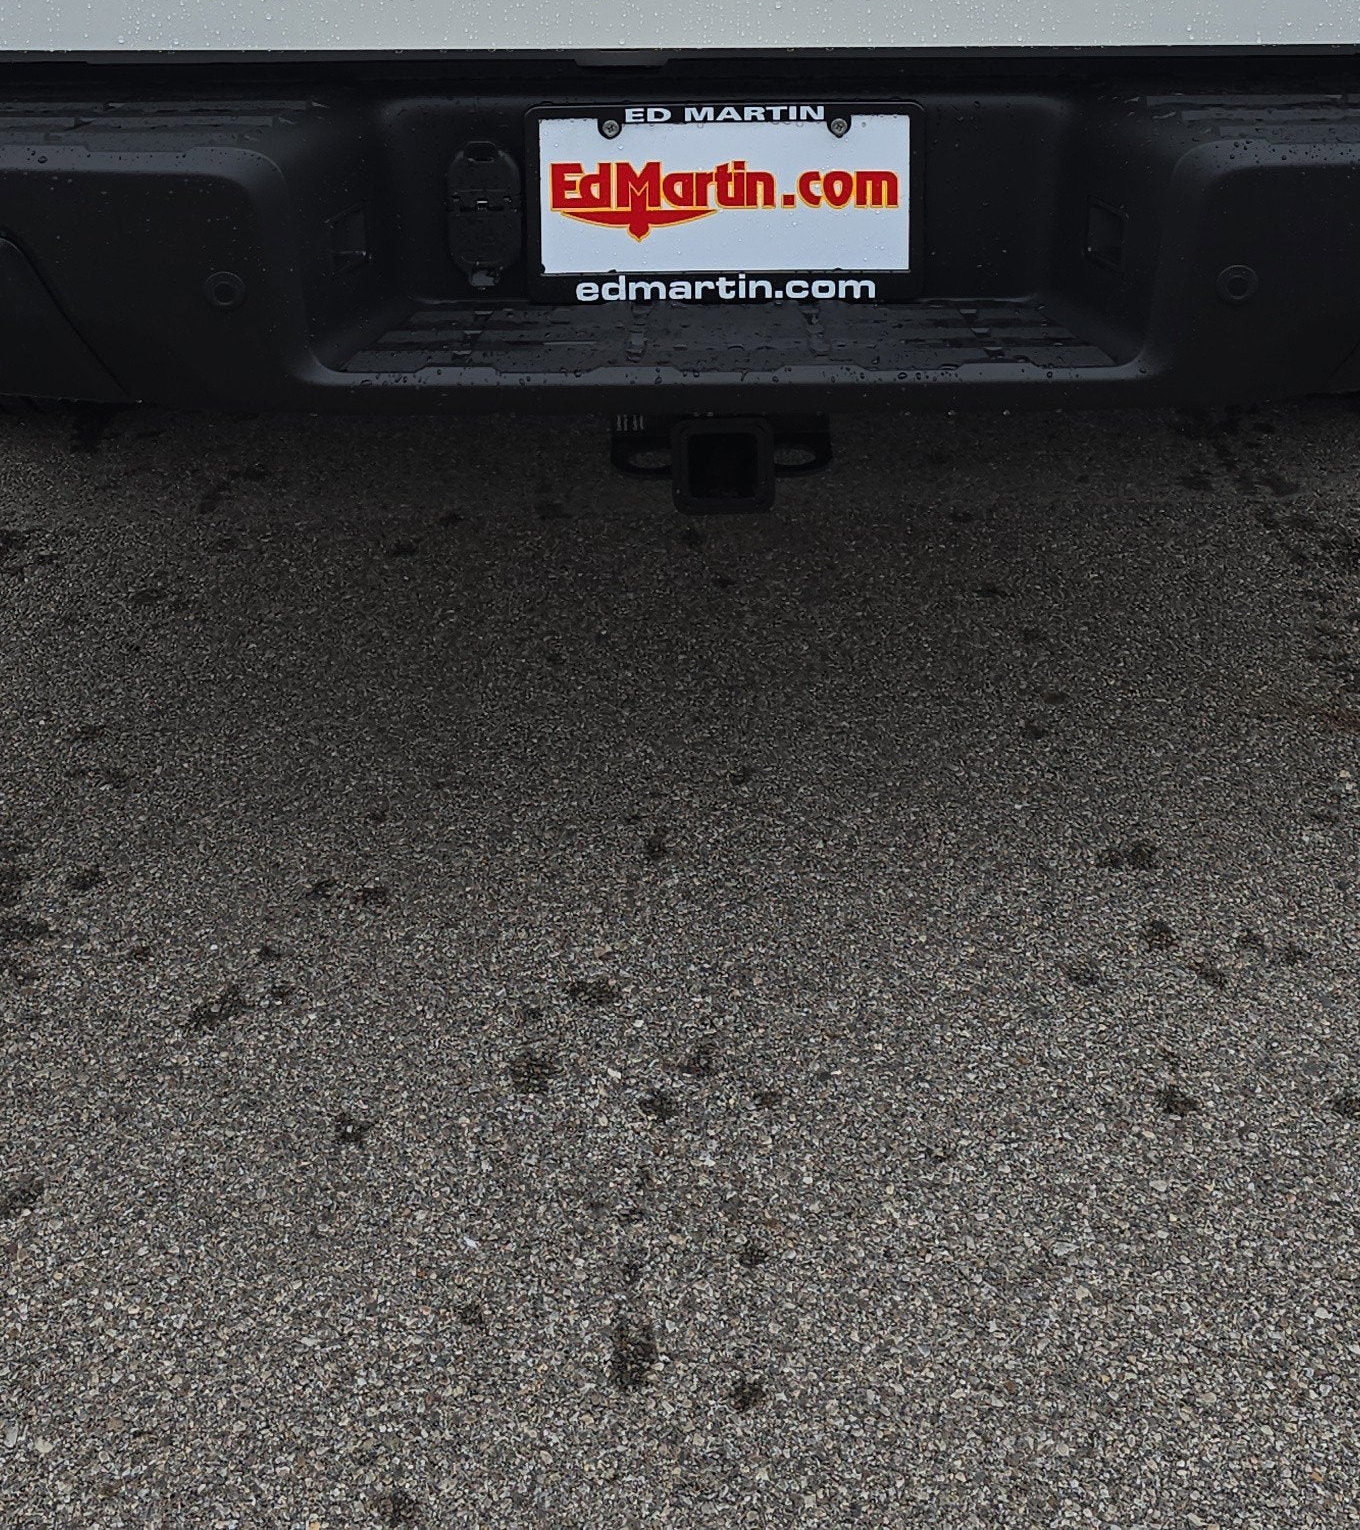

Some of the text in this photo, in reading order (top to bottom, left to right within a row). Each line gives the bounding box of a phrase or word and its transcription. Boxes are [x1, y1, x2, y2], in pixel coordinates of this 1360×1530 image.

[625, 105, 825, 122] ED MARTIN
[550, 161, 901, 210] EdMartin.com
[575, 275, 877, 302] edmartin.com
